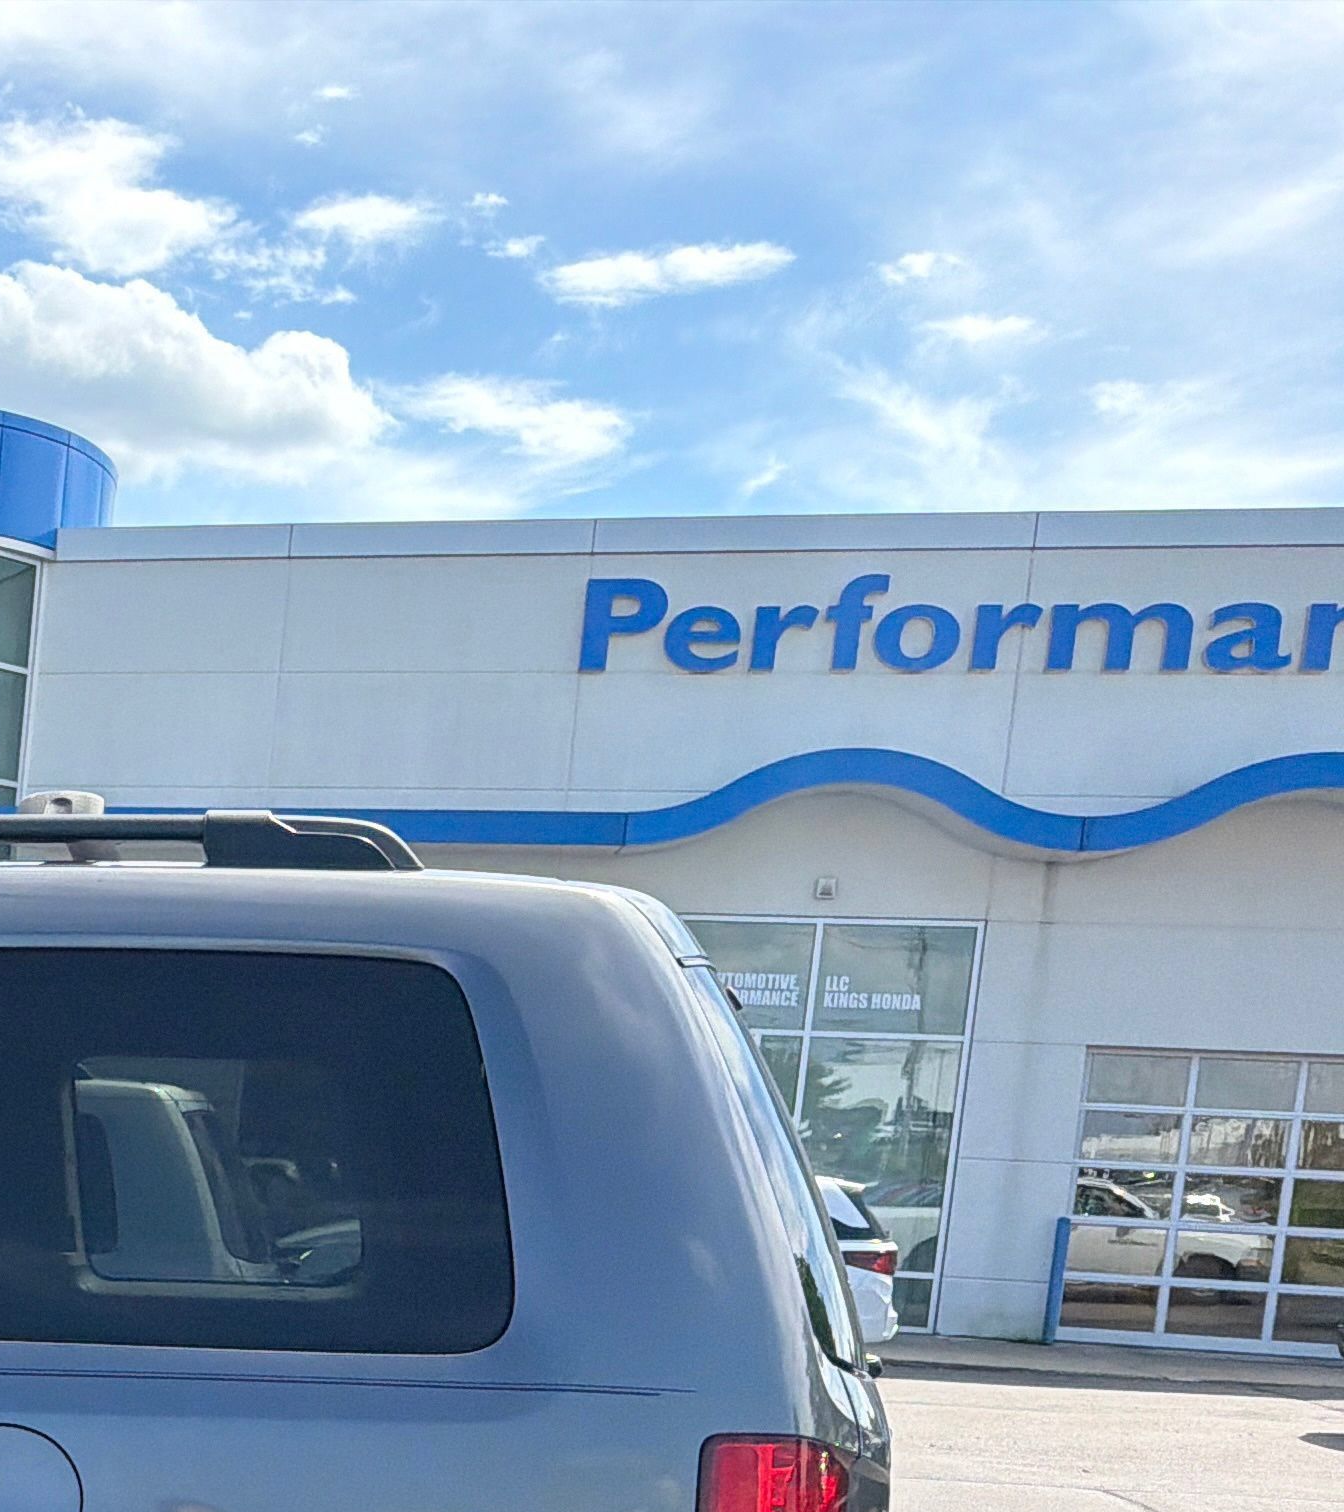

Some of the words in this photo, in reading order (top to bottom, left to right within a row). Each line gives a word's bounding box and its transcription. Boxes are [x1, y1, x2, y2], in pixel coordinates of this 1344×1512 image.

[715, 972, 799, 990] UTOMOTIVE
[825, 975, 850, 991] LLC
[824, 991, 869, 1008] KINGS
[870, 993, 921, 1010] HONDA
